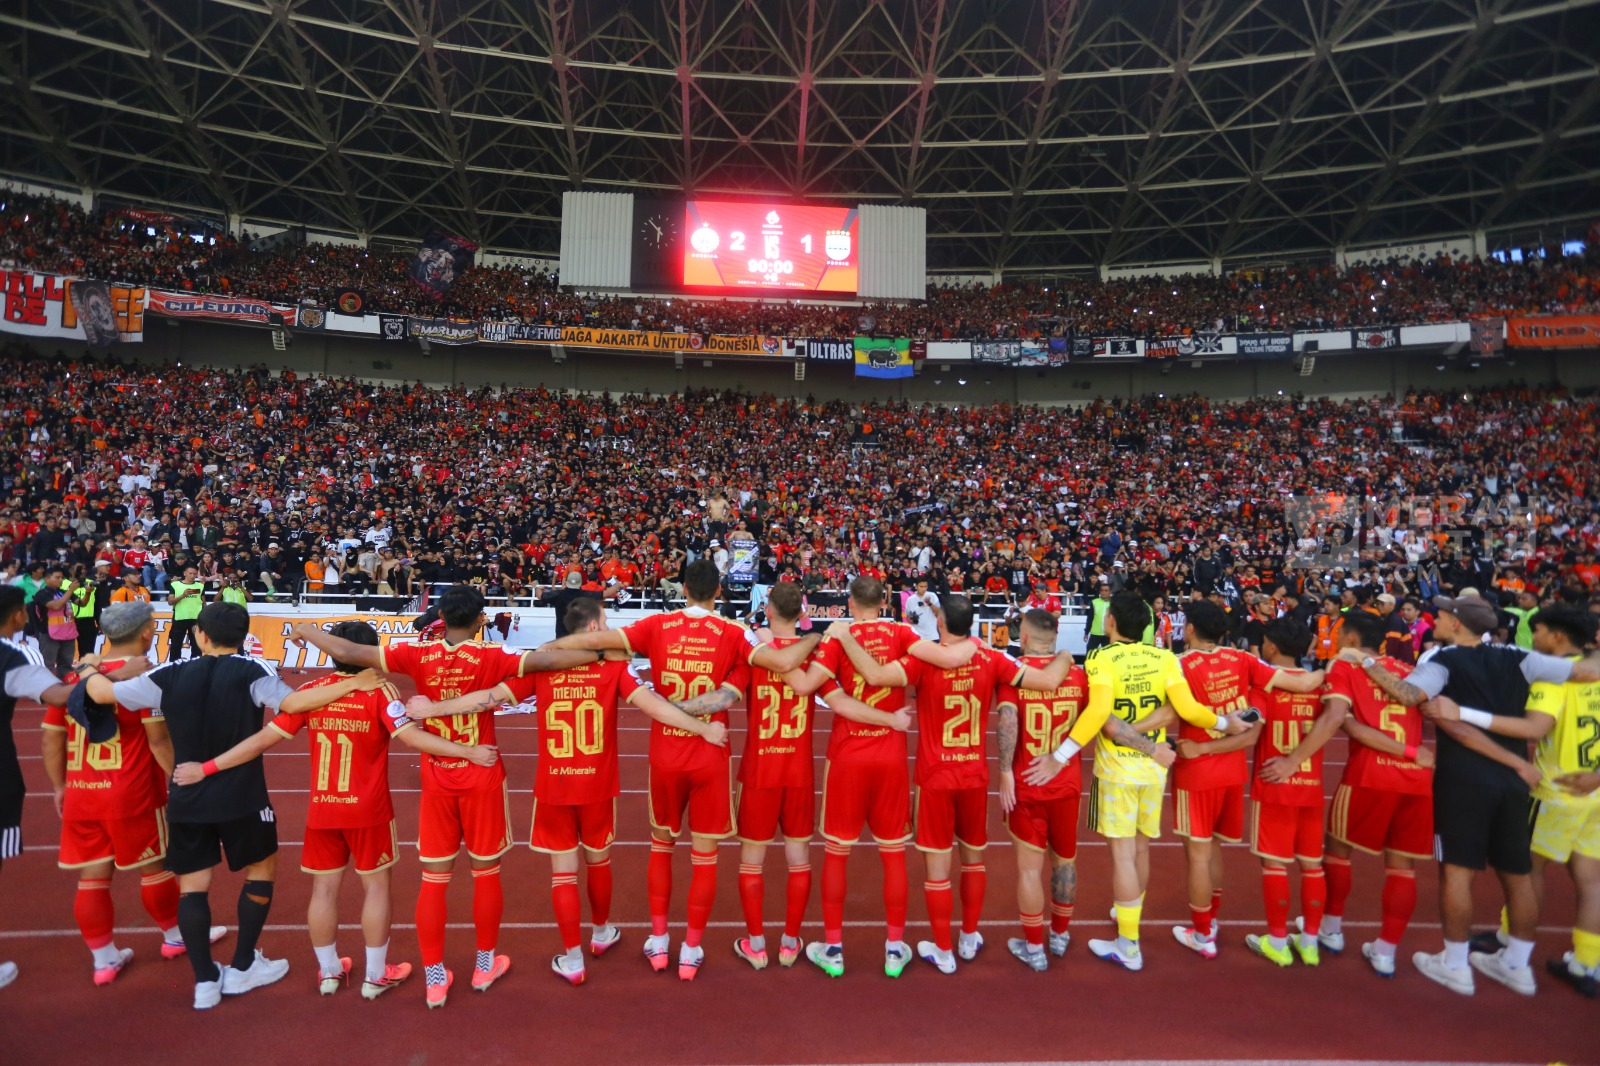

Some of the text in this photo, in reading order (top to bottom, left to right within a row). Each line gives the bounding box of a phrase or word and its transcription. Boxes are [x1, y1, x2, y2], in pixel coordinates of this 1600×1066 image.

[729, 231, 746, 250] 2
[801, 234, 812, 254] 1
[1366, 244, 1426, 257] SEKTOR
[502, 256, 550, 266] SEKTOR
[748, 259, 793, 274] 90:00
[4, 292, 47, 326] BE
[420, 325, 478, 338] MARUNDA
[561, 330, 593, 343] JAGA
[596, 330, 650, 347] JAKARTA
[701, 336, 761, 352] NDONESIA
[810, 342, 853, 360] ULTRAS
[1145, 347, 1179, 358] PERSIJA
[662, 618, 684, 630] UPbit
[666, 657, 713, 674] HOLINGER
[553, 686, 597, 700] MEMIJA
[1124, 681, 1151, 695] NADEO
[328, 702, 365, 710] HONGSAM
[757, 685, 809, 740] 33
[1291, 704, 1314, 717] FIGO
[942, 693, 982, 748] 21
[1379, 703, 1407, 745] 5
[545, 699, 604, 758] 50
[662, 726, 671, 736] Le
[1025, 700, 1078, 757] 92
[765, 745, 796, 755] Minerale
[941, 752, 980, 762] Le Minerale
[316, 732, 353, 793] 11
[549, 766, 596, 775] Le Minerale
[72, 779, 112, 790] Minerale
[320, 794, 358, 804] Minerale
